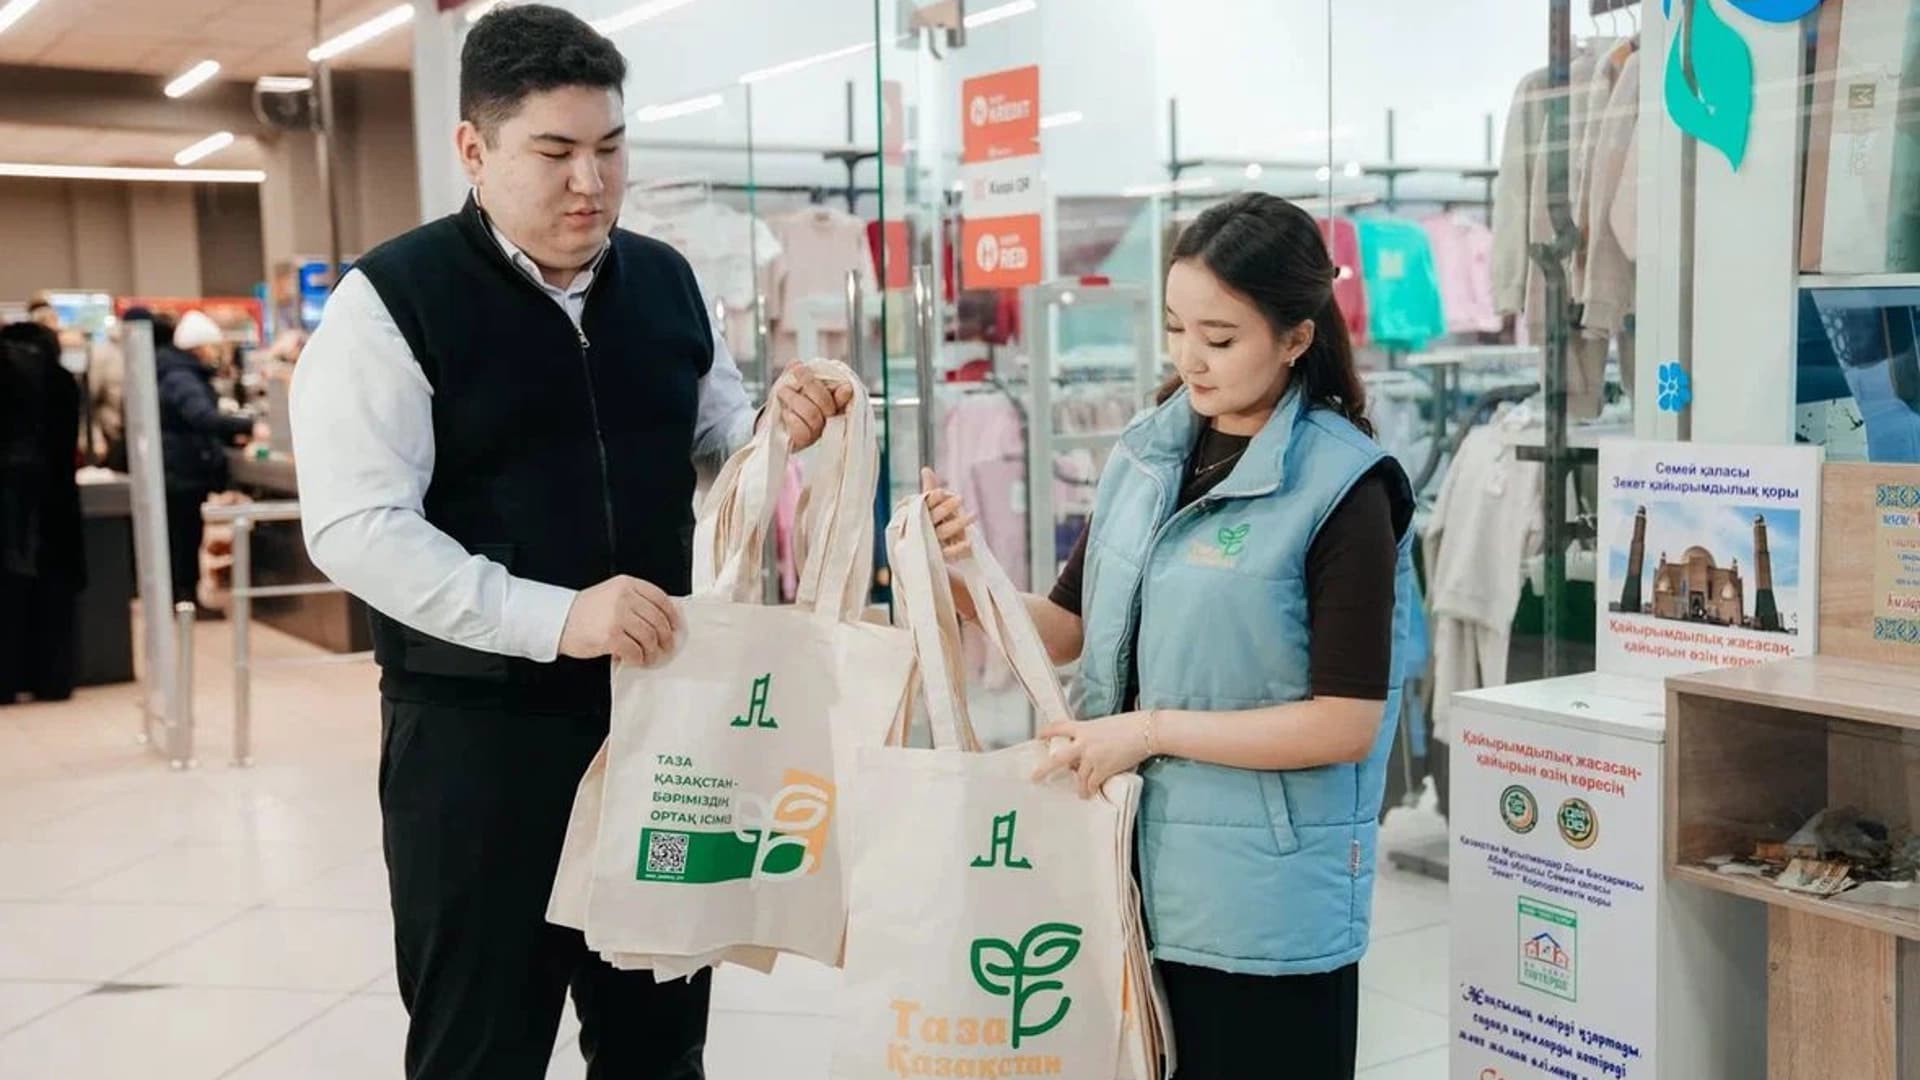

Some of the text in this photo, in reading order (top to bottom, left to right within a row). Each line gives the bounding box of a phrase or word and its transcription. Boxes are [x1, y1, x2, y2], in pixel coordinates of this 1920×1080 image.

[1656, 462, 1750, 479] Семей қаласы
[1613, 476, 1799, 500] Зекет қайырымдылық қоры
[1609, 619, 1724, 647] Қайырымдылық
[1624, 641, 1686, 659] қайырын
[1690, 651, 1719, 664] өзің
[657, 754, 692, 768] ТАЗА
[1462, 729, 1642, 781] Қайырымдылық жасасаң-
[654, 773, 739, 789] ҚАЗАҚСТАН-
[1476, 754, 1625, 797] қайырын өзің көресің
[650, 810, 697, 825] ОРТАҚ
[889, 999, 1009, 1046] Таза
[886, 1042, 1063, 1080] Қазақстан
